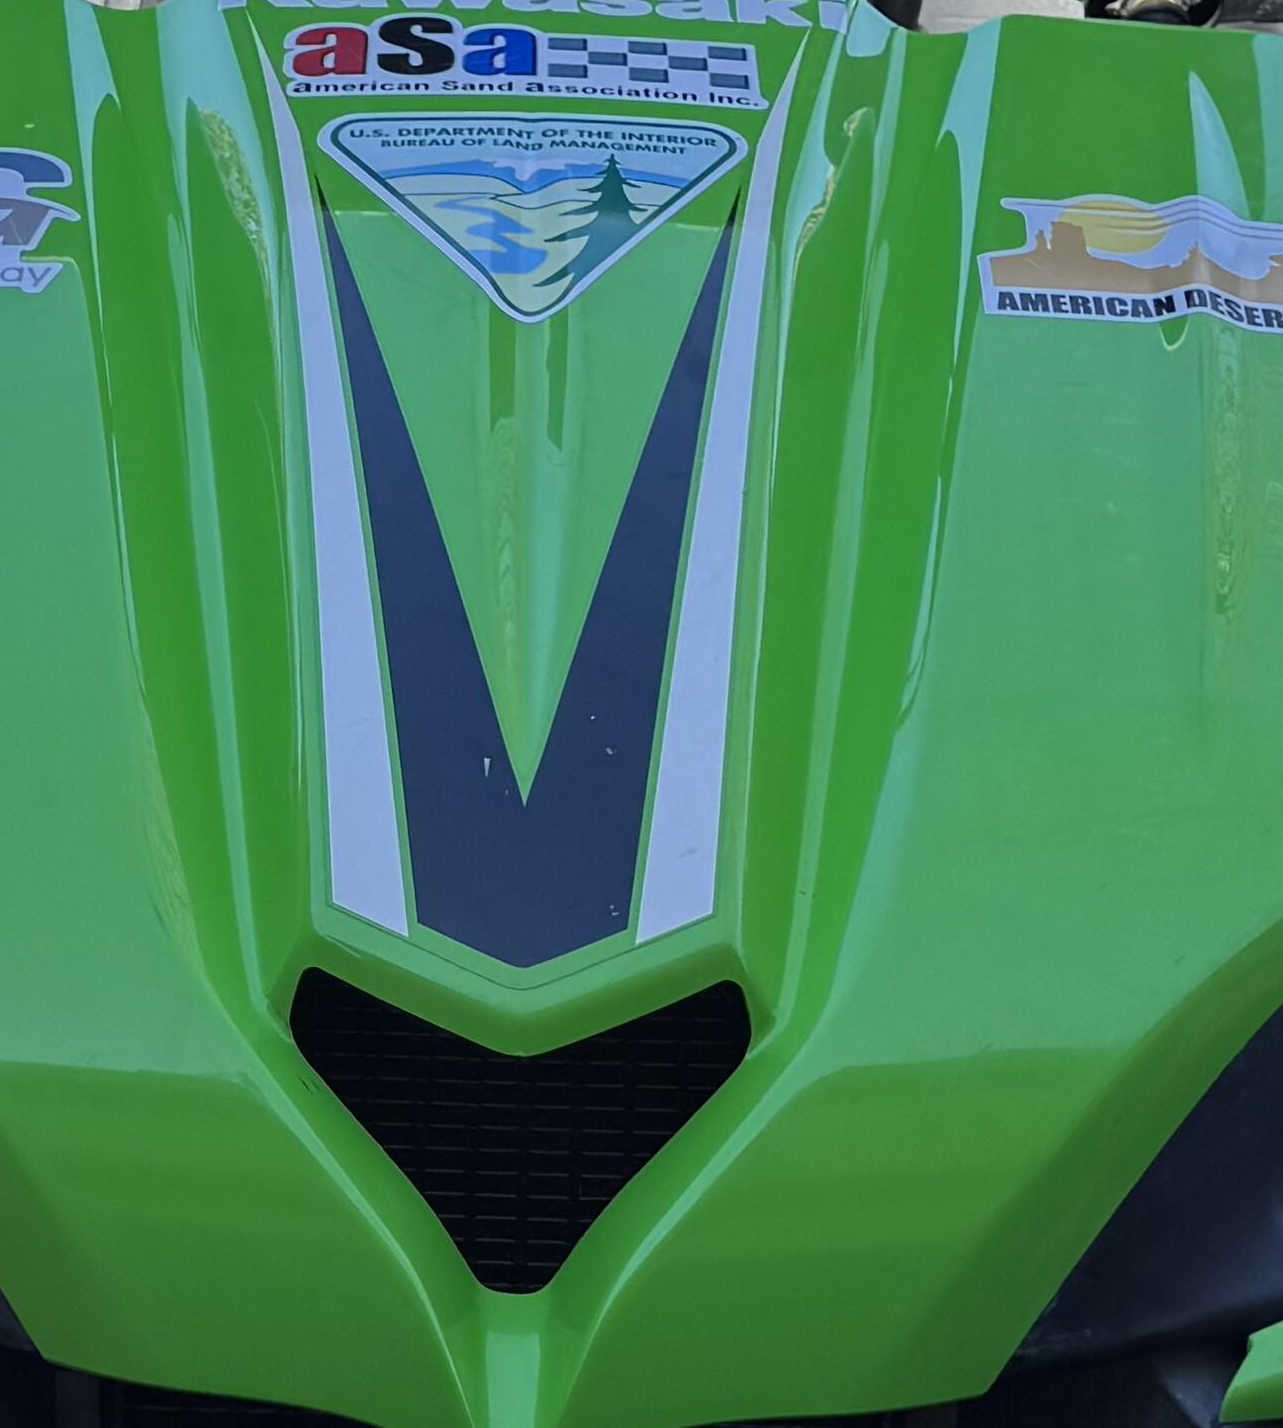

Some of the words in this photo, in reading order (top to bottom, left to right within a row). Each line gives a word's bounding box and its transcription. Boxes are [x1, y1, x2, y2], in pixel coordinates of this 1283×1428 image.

[441, 79, 513, 93] Sand
[708, 91, 760, 107] Inc.
[349, 128, 390, 139] U.S.
[398, 127, 534, 140] DEPARTMENT
[541, 128, 569, 139] OF
[574, 129, 614, 140] THE
[621, 131, 717, 147] INTERIOR
[380, 137, 455, 148] BUREAU
[461, 138, 487, 147] OF
[493, 137, 543, 151] LAND
[549, 138, 687, 155] MANAGEMENT
[998, 291, 1177, 318] AMERICAN
